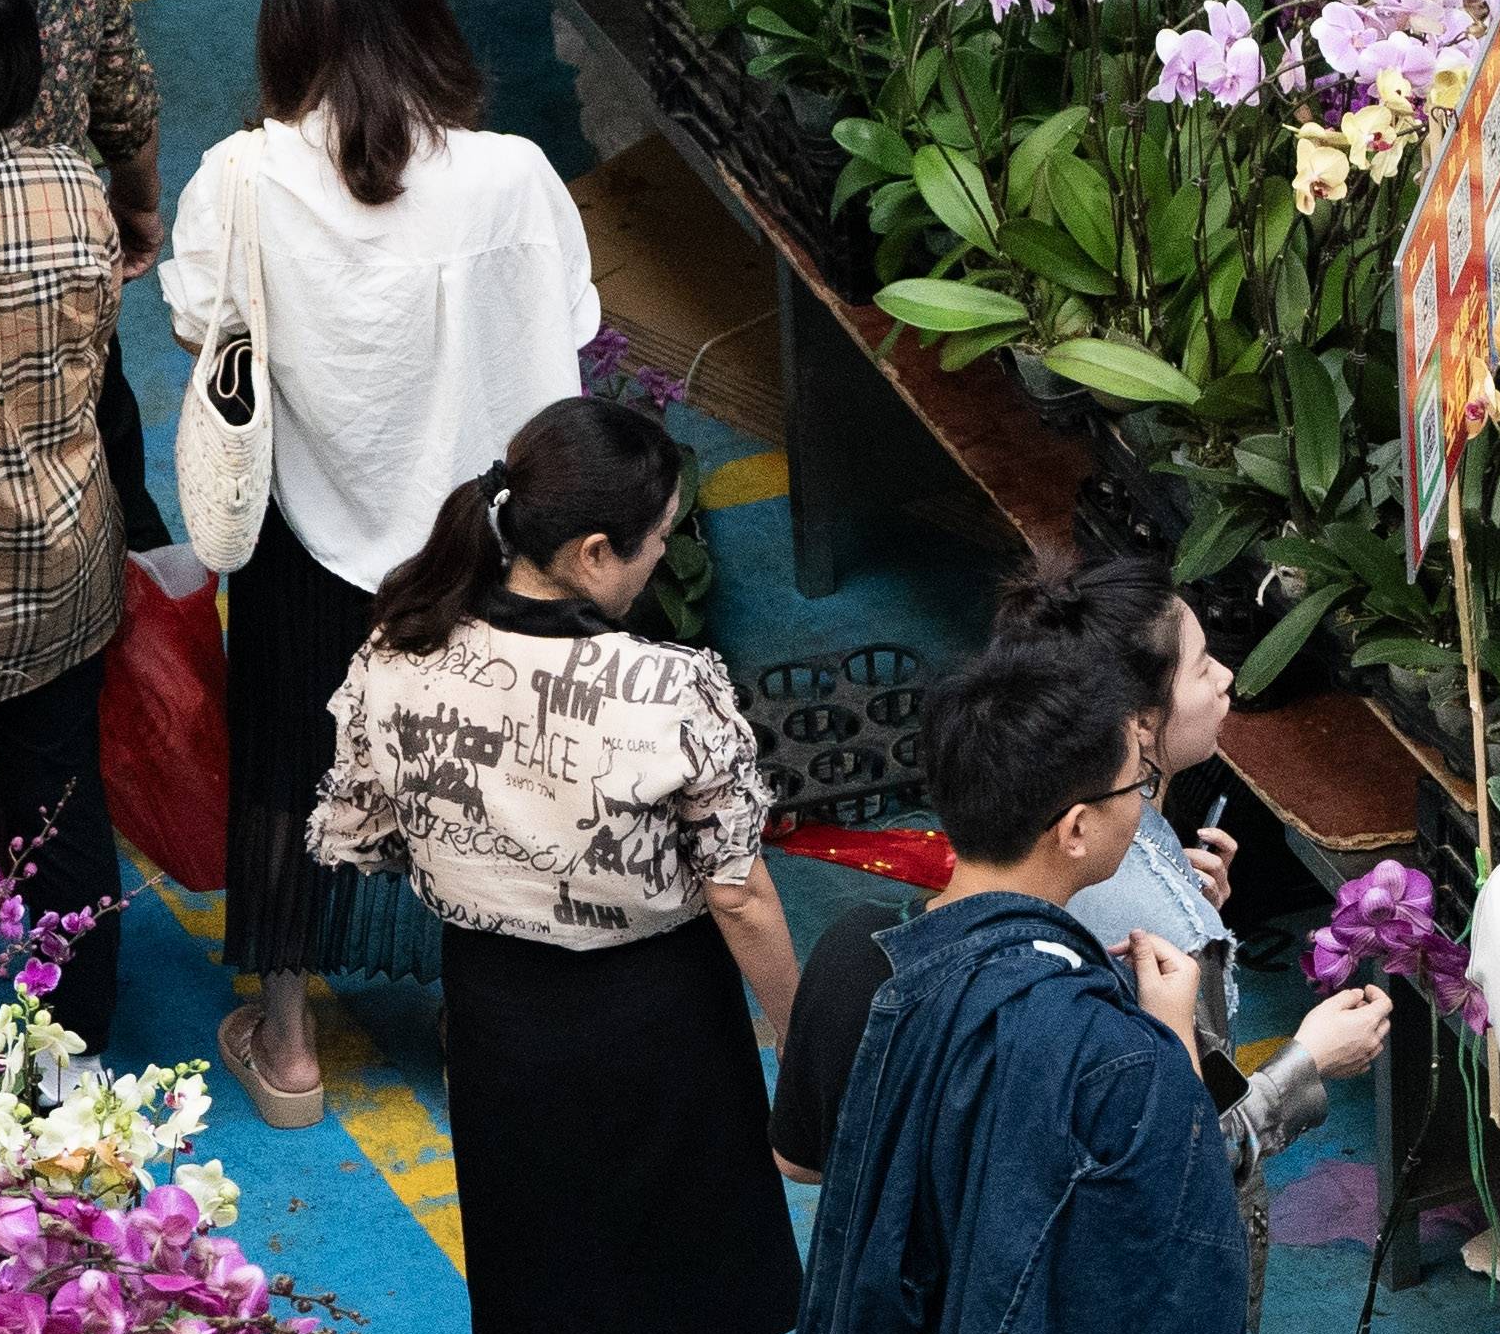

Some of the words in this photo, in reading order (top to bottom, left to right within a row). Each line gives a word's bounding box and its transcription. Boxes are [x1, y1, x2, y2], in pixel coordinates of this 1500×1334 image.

[562, 638, 691, 705] PACE
[501, 715, 579, 784] PEACE
[602, 736, 624, 750] MCC
[627, 739, 657, 754] CLARE
